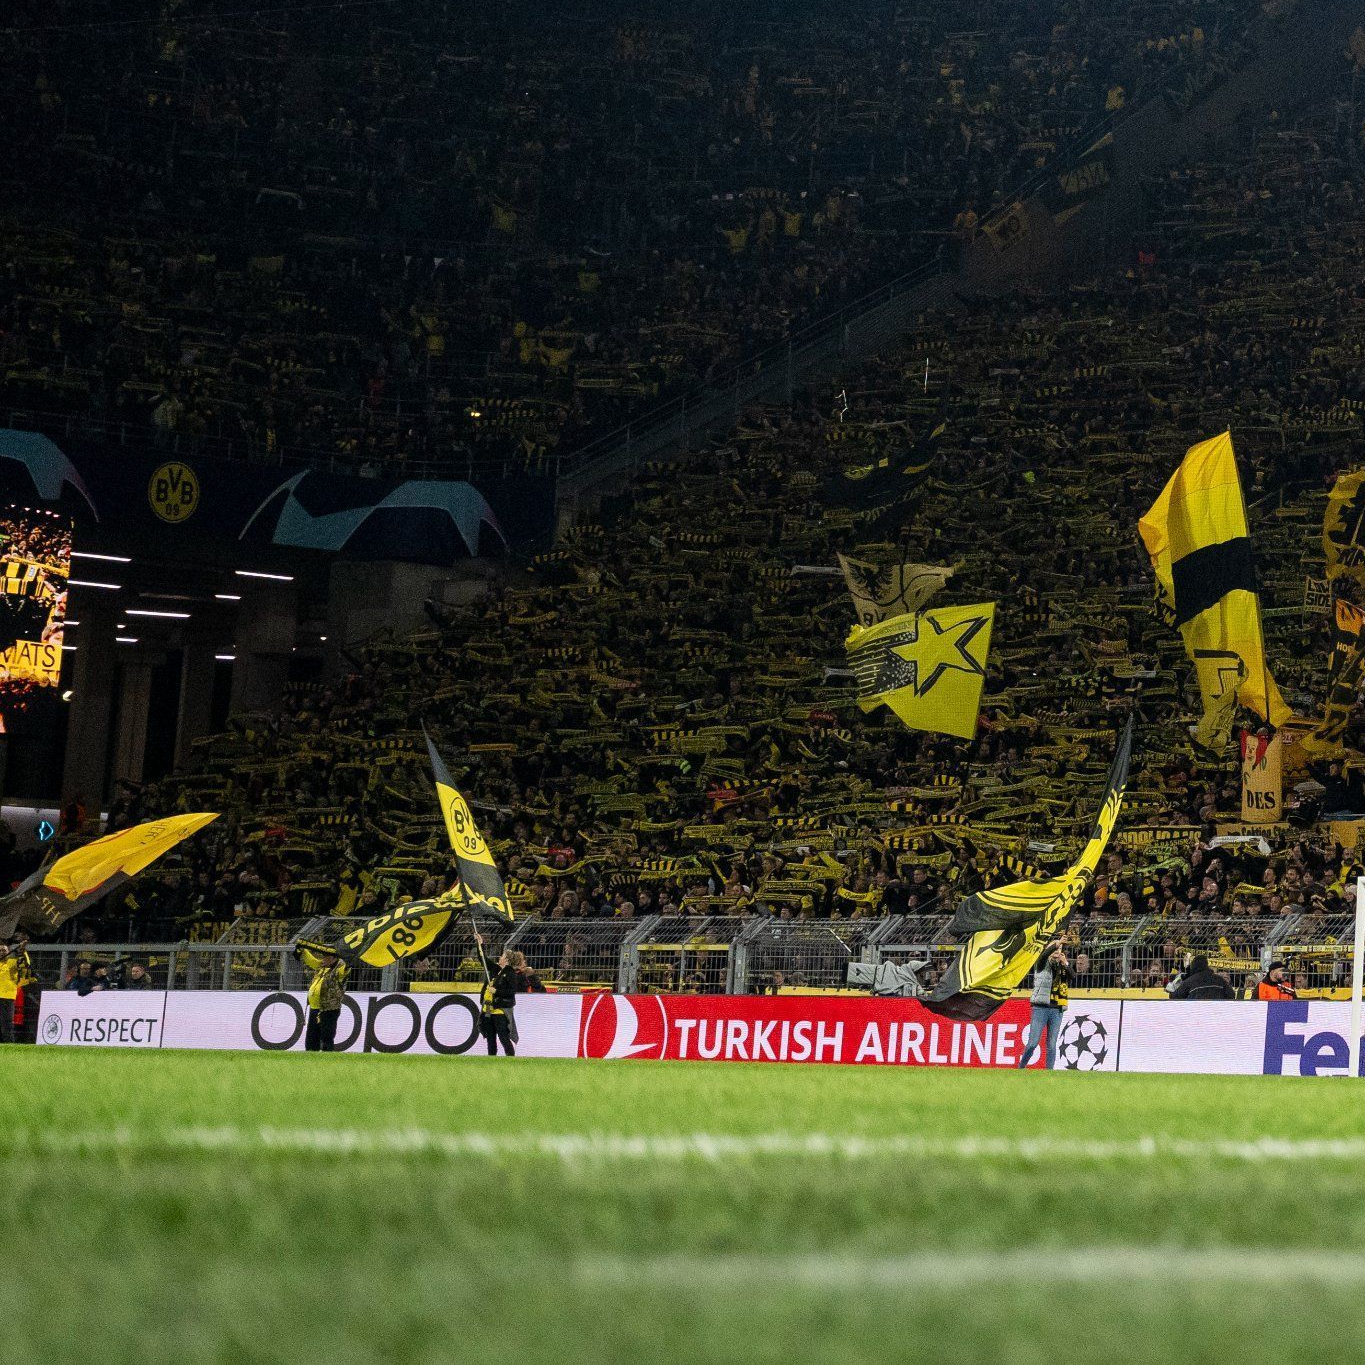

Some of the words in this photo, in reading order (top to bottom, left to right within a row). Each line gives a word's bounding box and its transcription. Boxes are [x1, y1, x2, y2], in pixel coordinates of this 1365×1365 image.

[155, 469, 194, 504] BVB
[165, 503, 181, 517] 09
[1247, 790, 1276, 809] DES
[463, 836, 477, 850] 09
[70, 1018, 157, 1042] RESPECT
[675, 1019, 840, 1062] TURKISH
[856, 1021, 1042, 1066] AIRLINES
